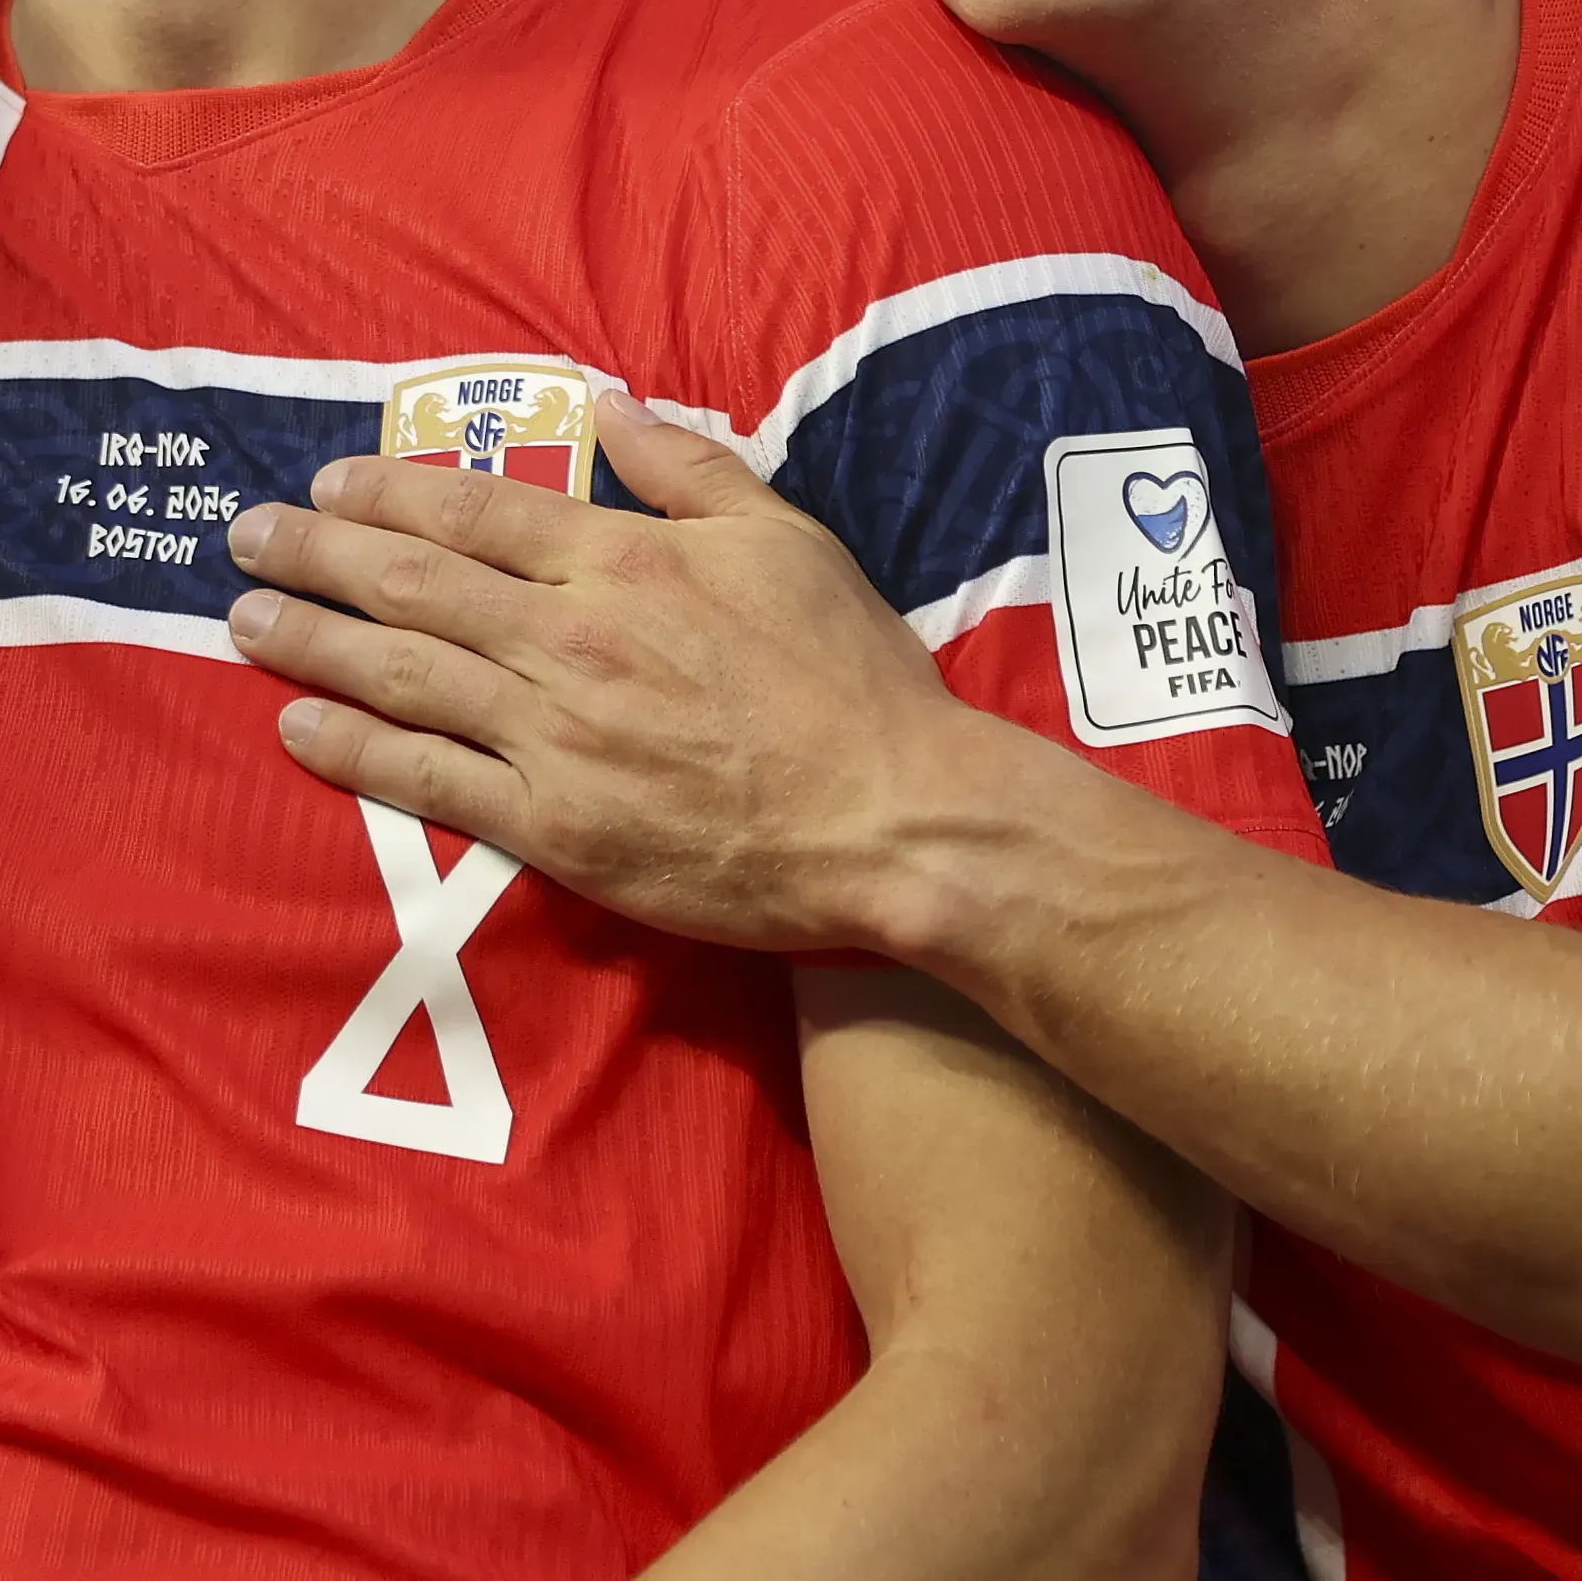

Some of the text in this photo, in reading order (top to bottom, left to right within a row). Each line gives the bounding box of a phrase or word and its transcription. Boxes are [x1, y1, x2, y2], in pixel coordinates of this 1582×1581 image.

[457, 378, 525, 406] NORGE
[99, 432, 211, 468] IRQ-NOR
[165, 485, 241, 522] 2026
[88, 523, 199, 566] BOSTON
[1116, 557, 1236, 621] Unite Fo
[1518, 592, 1574, 634] NORGE
[1132, 610, 1249, 670] PEACE
[1167, 667, 1237, 699] FIFA
